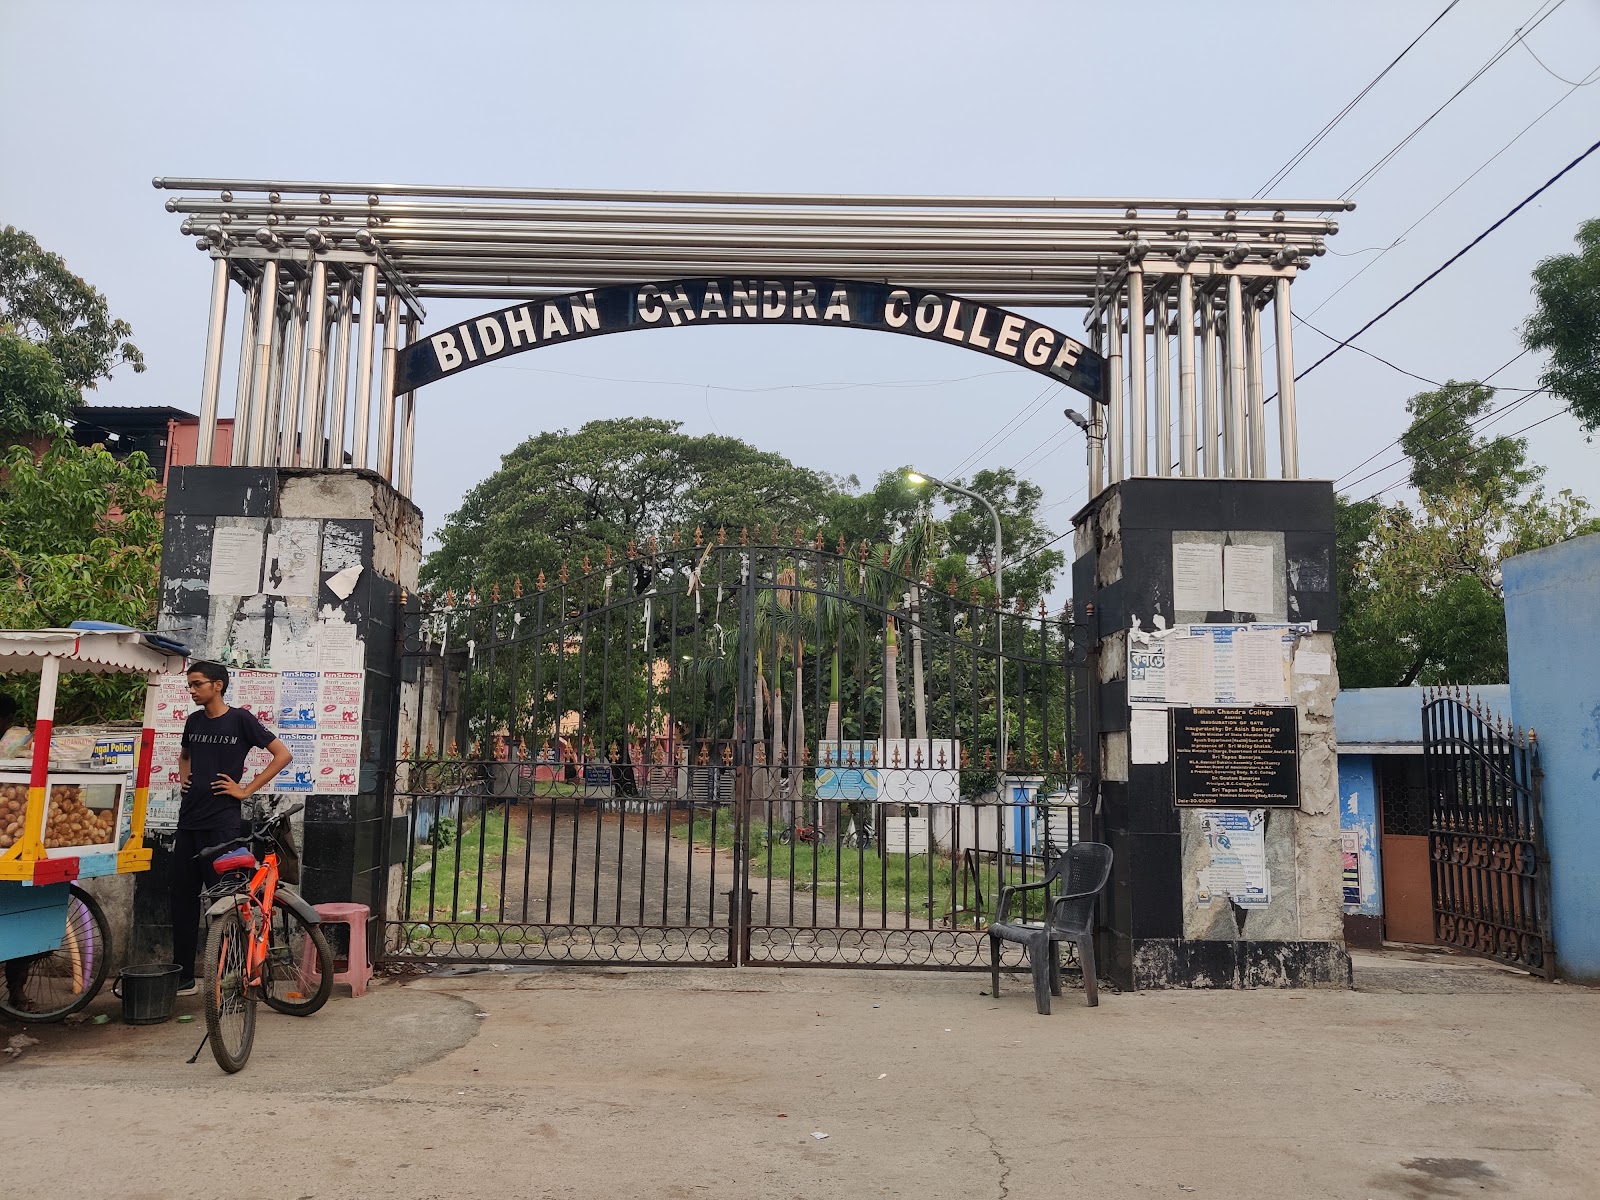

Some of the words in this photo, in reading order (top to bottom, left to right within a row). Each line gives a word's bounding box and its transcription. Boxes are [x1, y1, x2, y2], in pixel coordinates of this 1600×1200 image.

[431, 293, 600, 372] BIDHAN
[637, 280, 851, 326] CHANDRA
[884, 290, 1083, 380] COLLEGE
[111, 743, 133, 752] Police
